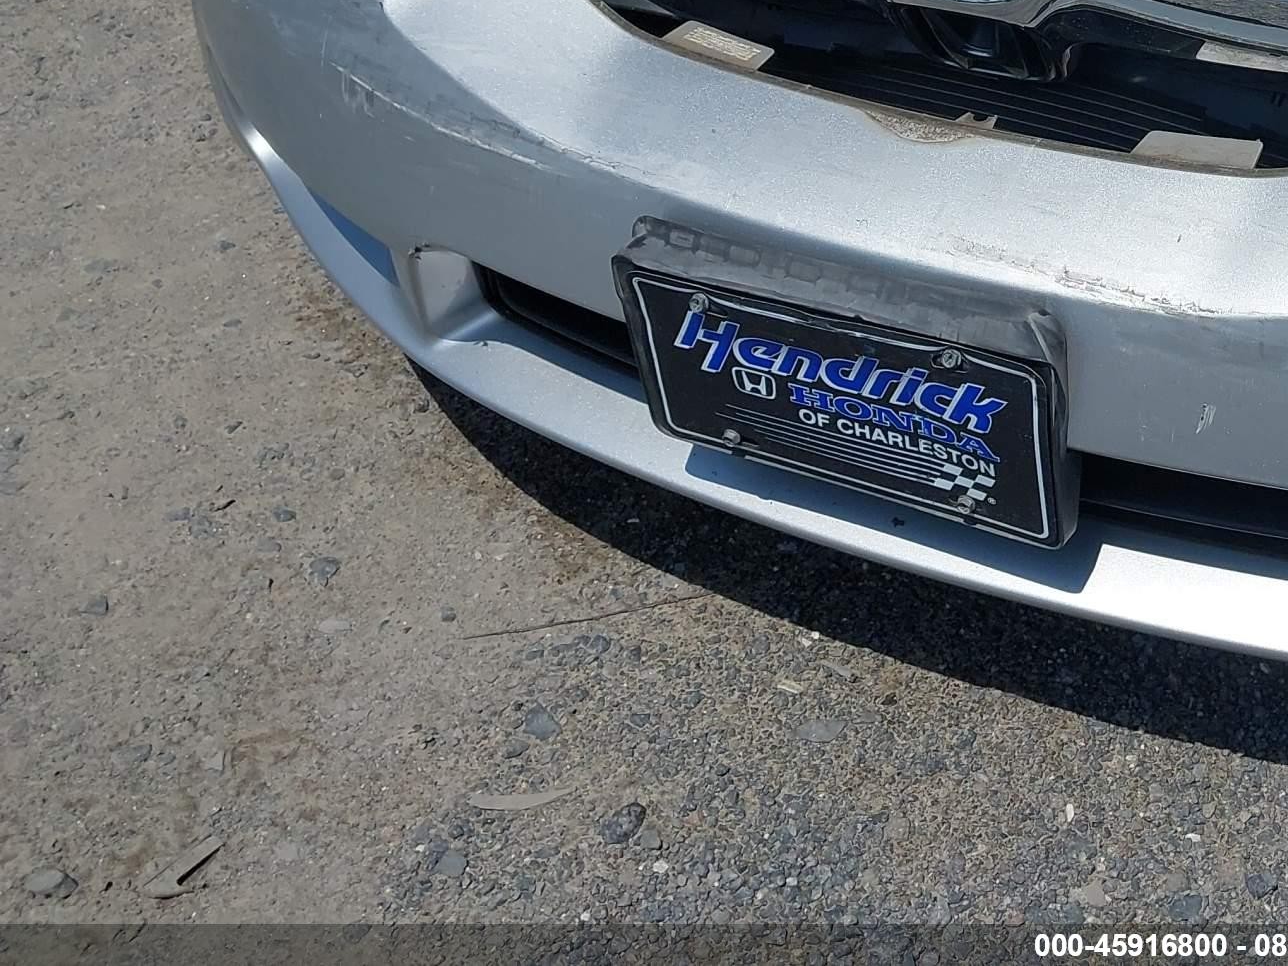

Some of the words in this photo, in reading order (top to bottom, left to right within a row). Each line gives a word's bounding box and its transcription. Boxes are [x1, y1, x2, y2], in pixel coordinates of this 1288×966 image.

[674, 309, 1008, 434] Hendrick
[788, 382, 1001, 463] HONDA
[798, 408, 830, 428] OF
[836, 418, 996, 477] CHARLESTON
